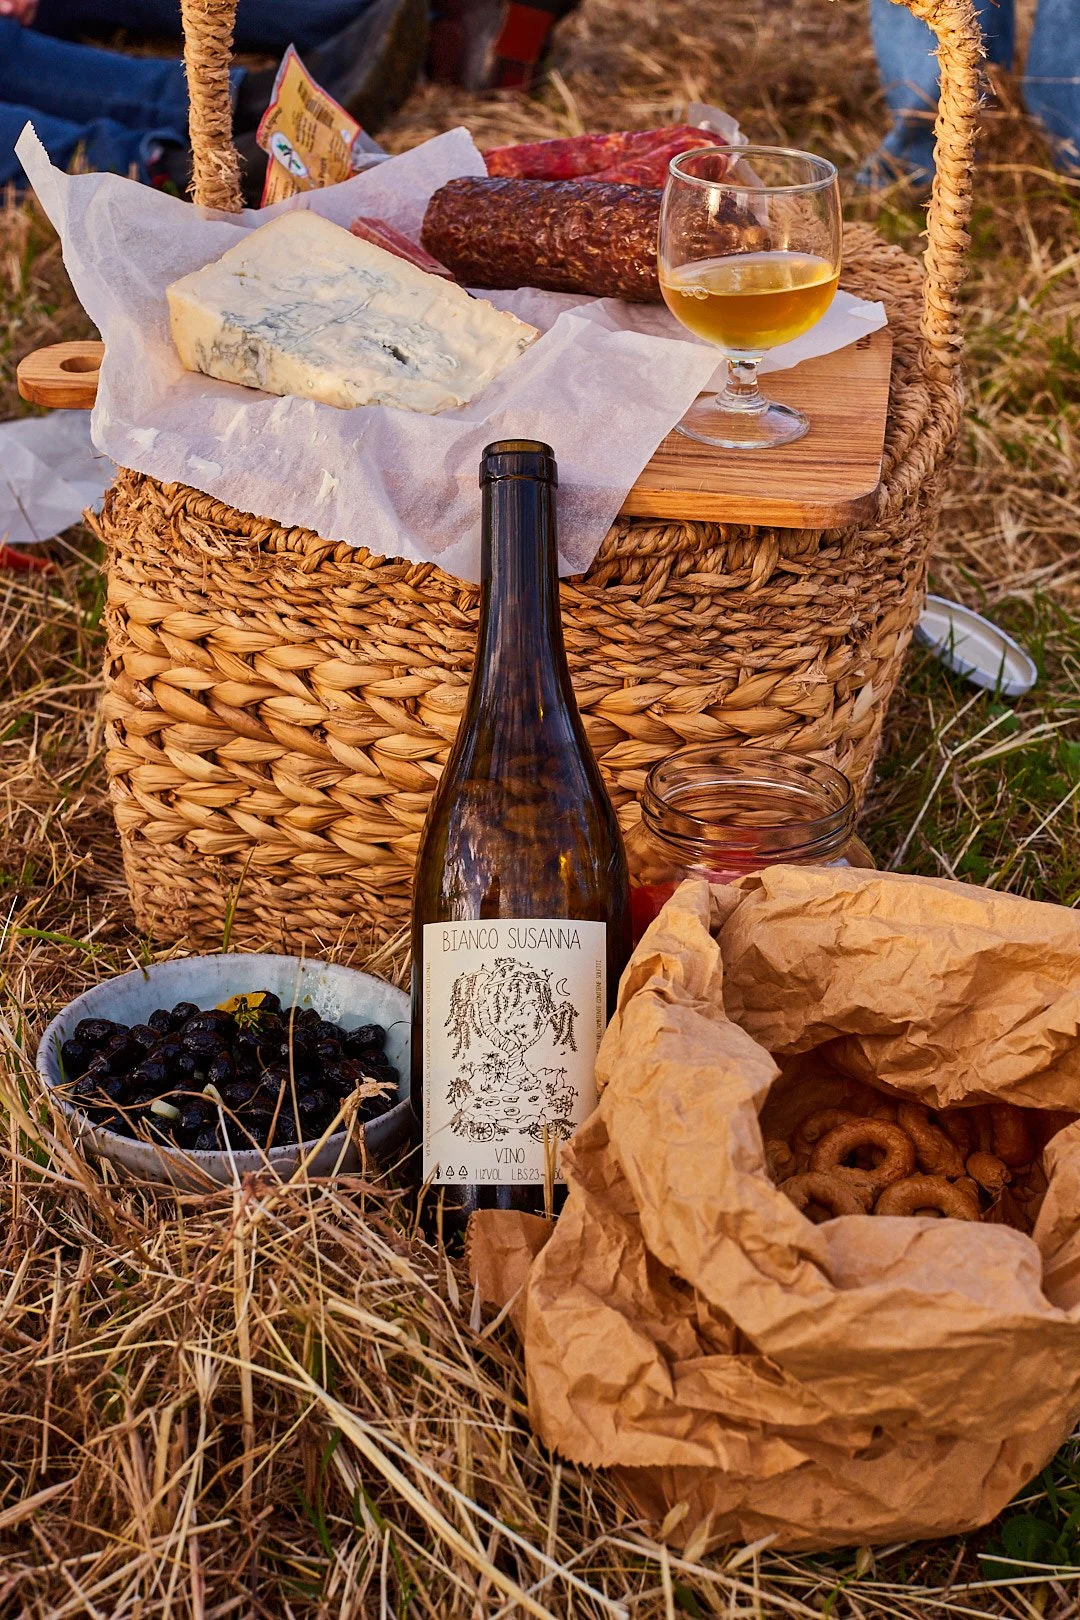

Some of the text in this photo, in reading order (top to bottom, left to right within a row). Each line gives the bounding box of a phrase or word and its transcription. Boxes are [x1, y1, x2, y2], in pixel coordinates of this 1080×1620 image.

[442, 927, 582, 952] BIANCO SUSANNA
[494, 1147, 526, 1164] VINO
